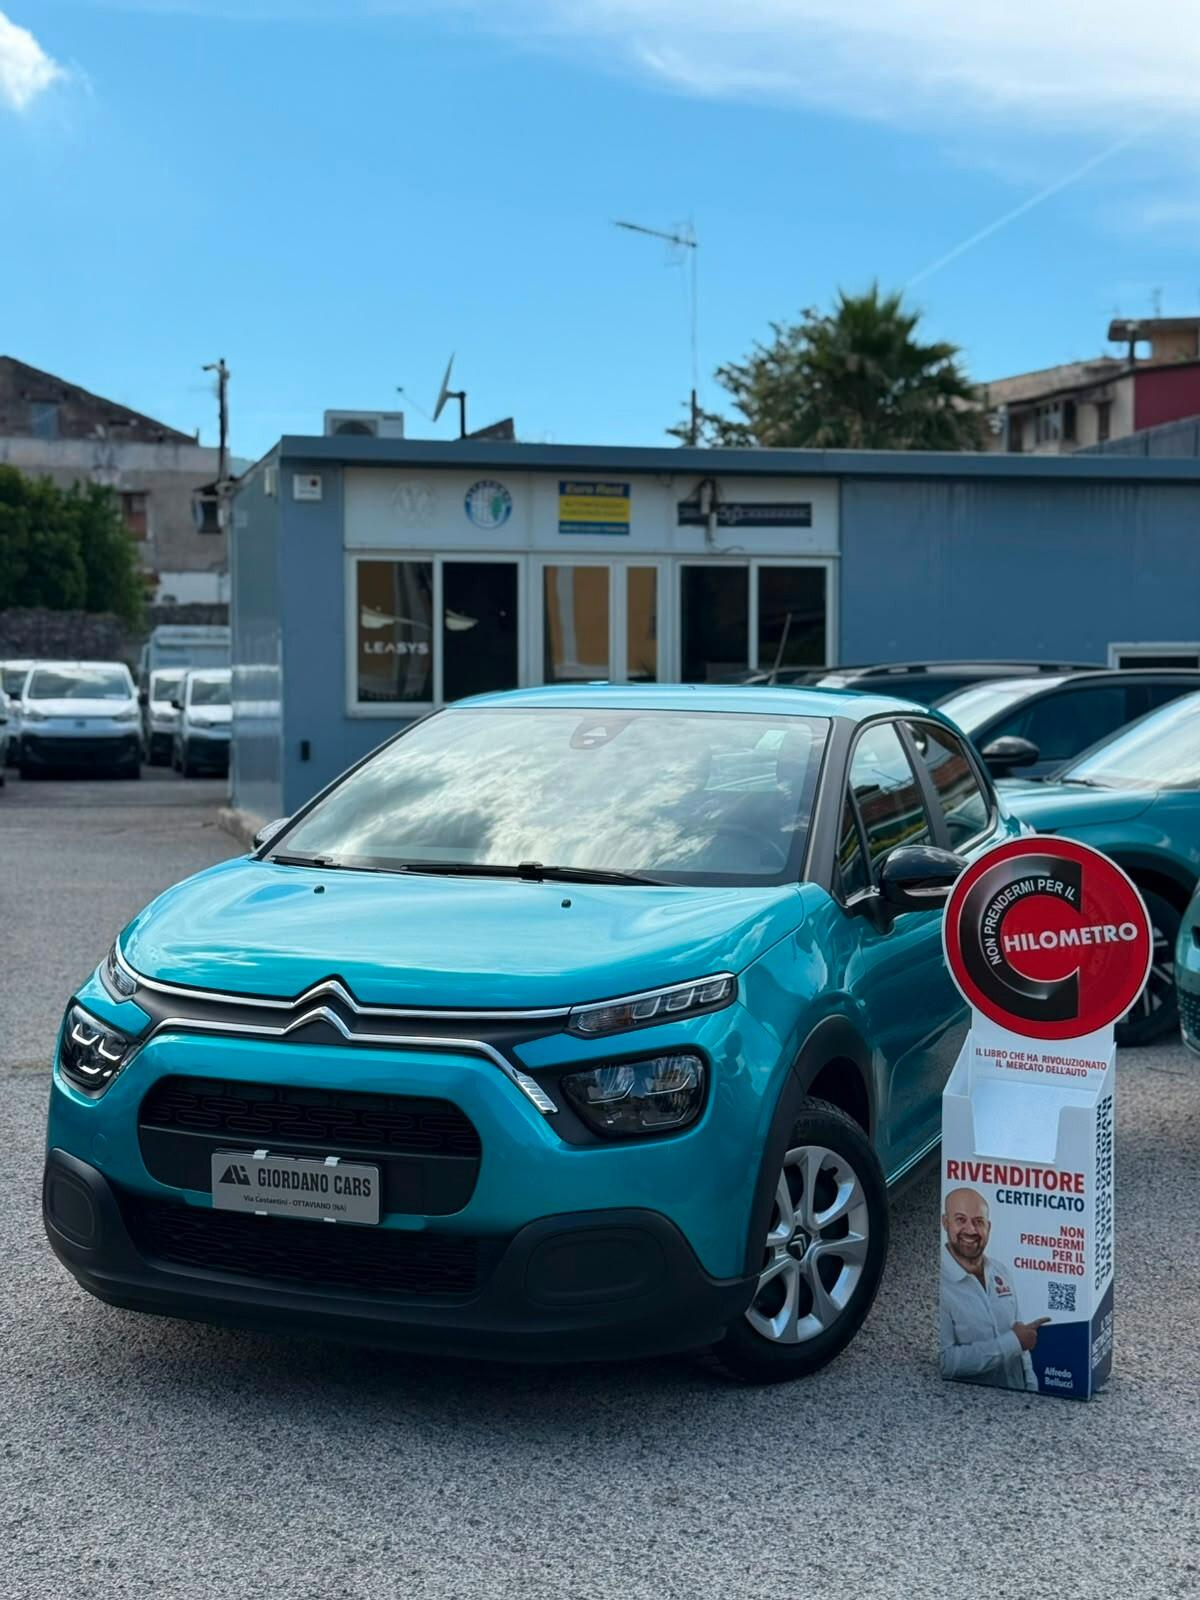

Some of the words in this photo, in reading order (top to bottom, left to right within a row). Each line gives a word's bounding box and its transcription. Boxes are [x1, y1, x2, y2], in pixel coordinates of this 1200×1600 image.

[363, 641, 430, 655] LEASYS
[1037, 879, 1064, 894] PER
[1064, 886, 1076, 901] IL
[984, 880, 1035, 935] PRENDERMI
[984, 938, 1002, 966] NON
[975, 1047, 982, 1057] IL
[984, 1049, 1008, 1059] LIBRO
[1009, 1051, 1025, 1061] CHE
[1026, 1053, 1038, 1063] HA
[1041, 1055, 1108, 1070] RIVOLUZIONATO
[995, 1059, 1002, 1068] IL
[1006, 1060, 1044, 1072] MERCATO
[1045, 1064, 1088, 1078] DELL'AUTO
[258, 1167, 329, 1194] GIORDANO
[333, 1175, 372, 1198] CARS
[946, 1159, 1085, 1194] RIVENDITORE
[243, 1194, 254, 1202] Via
[292, 1199, 331, 1210] OTTAVIANO
[996, 1189, 1085, 1212] CERTIFICATO
[1060, 1225, 1085, 1239] NON
[1020, 1233, 1084, 1251] PRENDERMI
[1052, 1249, 1073, 1262] PER
[1075, 1251, 1085, 1264] IL
[1013, 1257, 1085, 1276] CHILOMETRO
[1044, 1366, 1072, 1378] Alfredo
[1044, 1376, 1074, 1389] Bellucci
